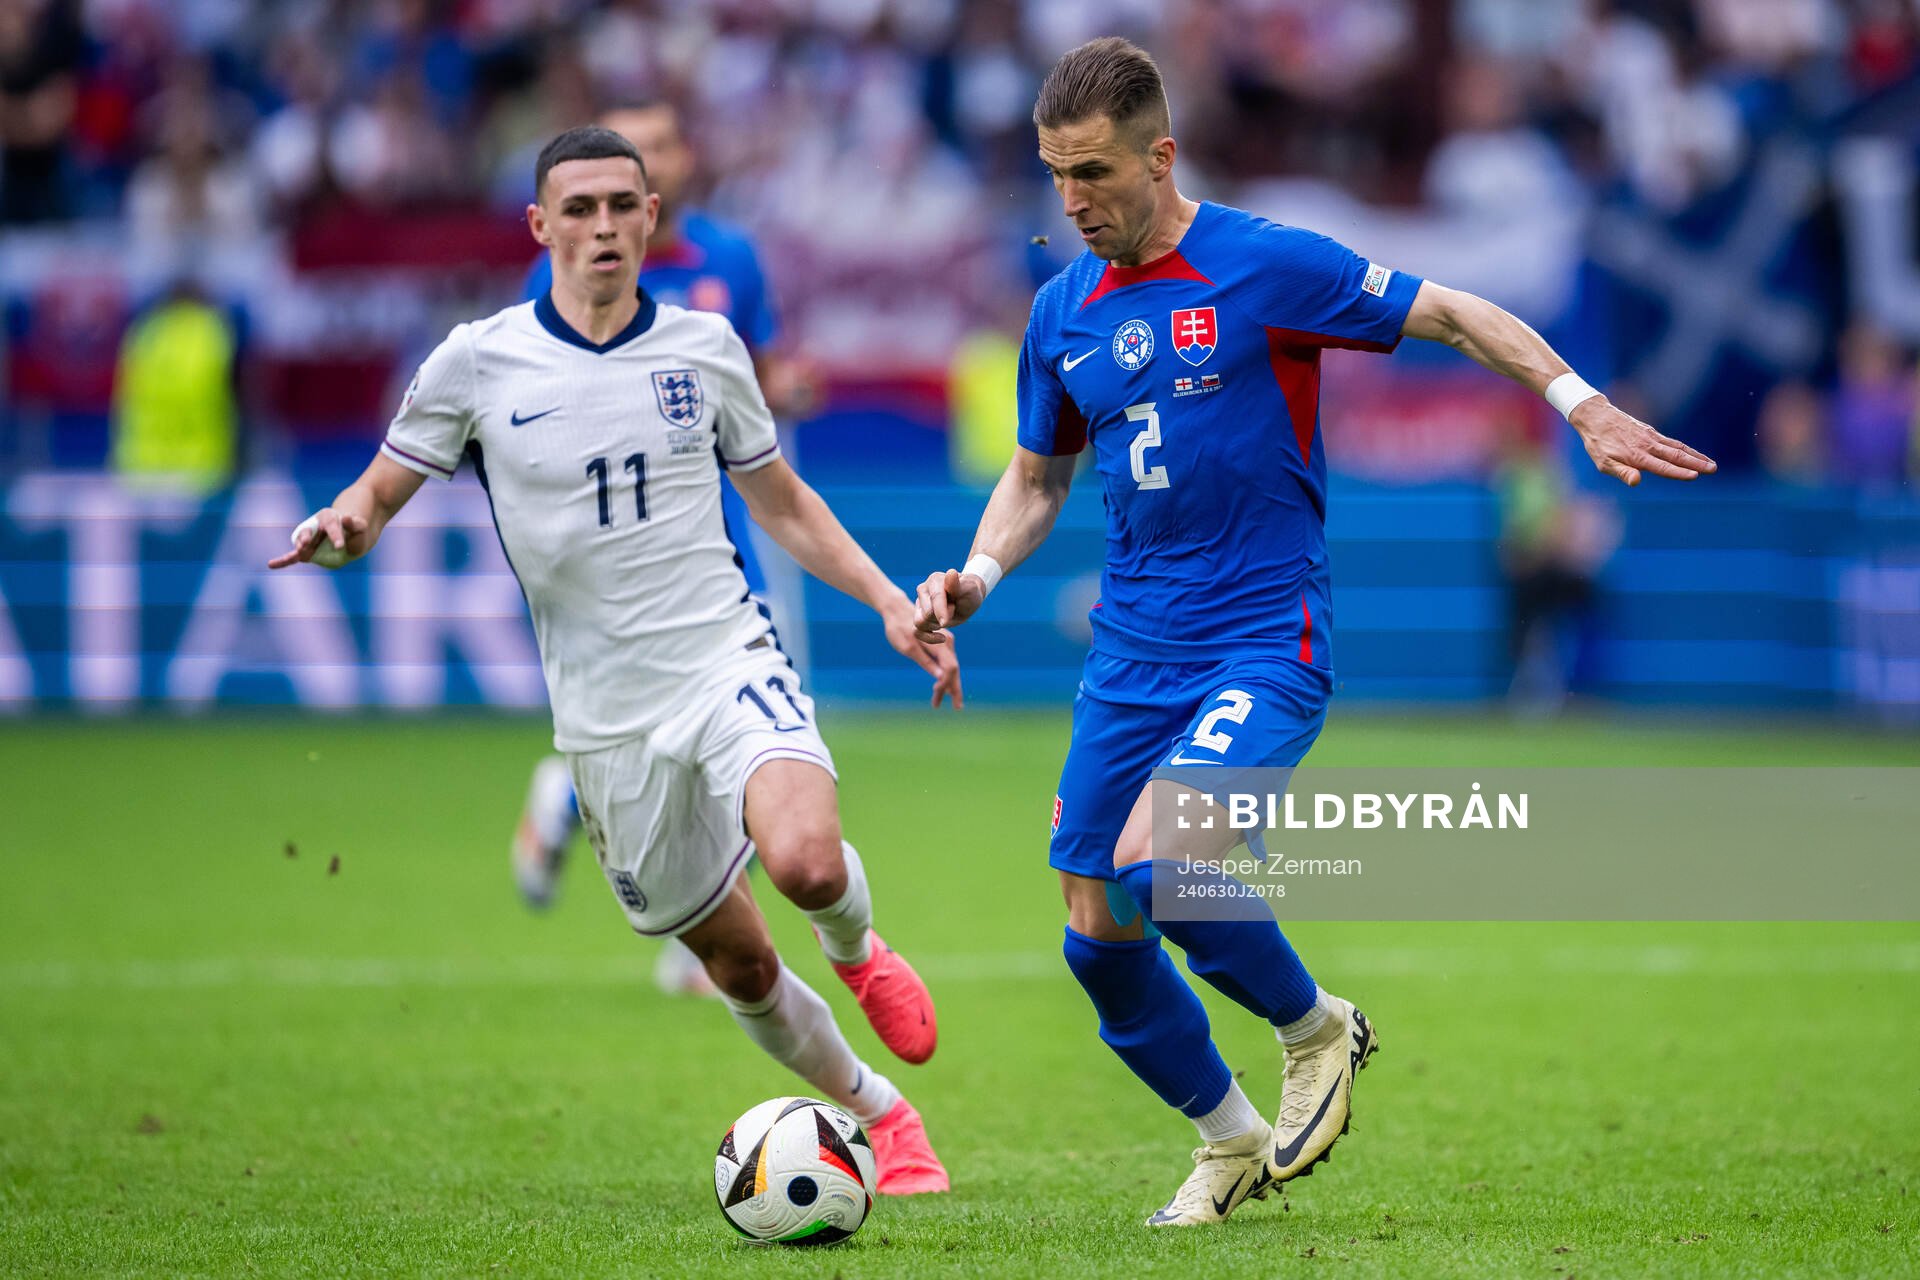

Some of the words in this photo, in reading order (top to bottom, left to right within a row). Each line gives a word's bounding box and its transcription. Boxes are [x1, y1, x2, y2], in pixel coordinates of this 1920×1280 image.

[1124, 402, 1171, 491] 2
[586, 452, 650, 529] 11
[736, 675, 808, 722] 11
[1190, 689, 1257, 755] 2
